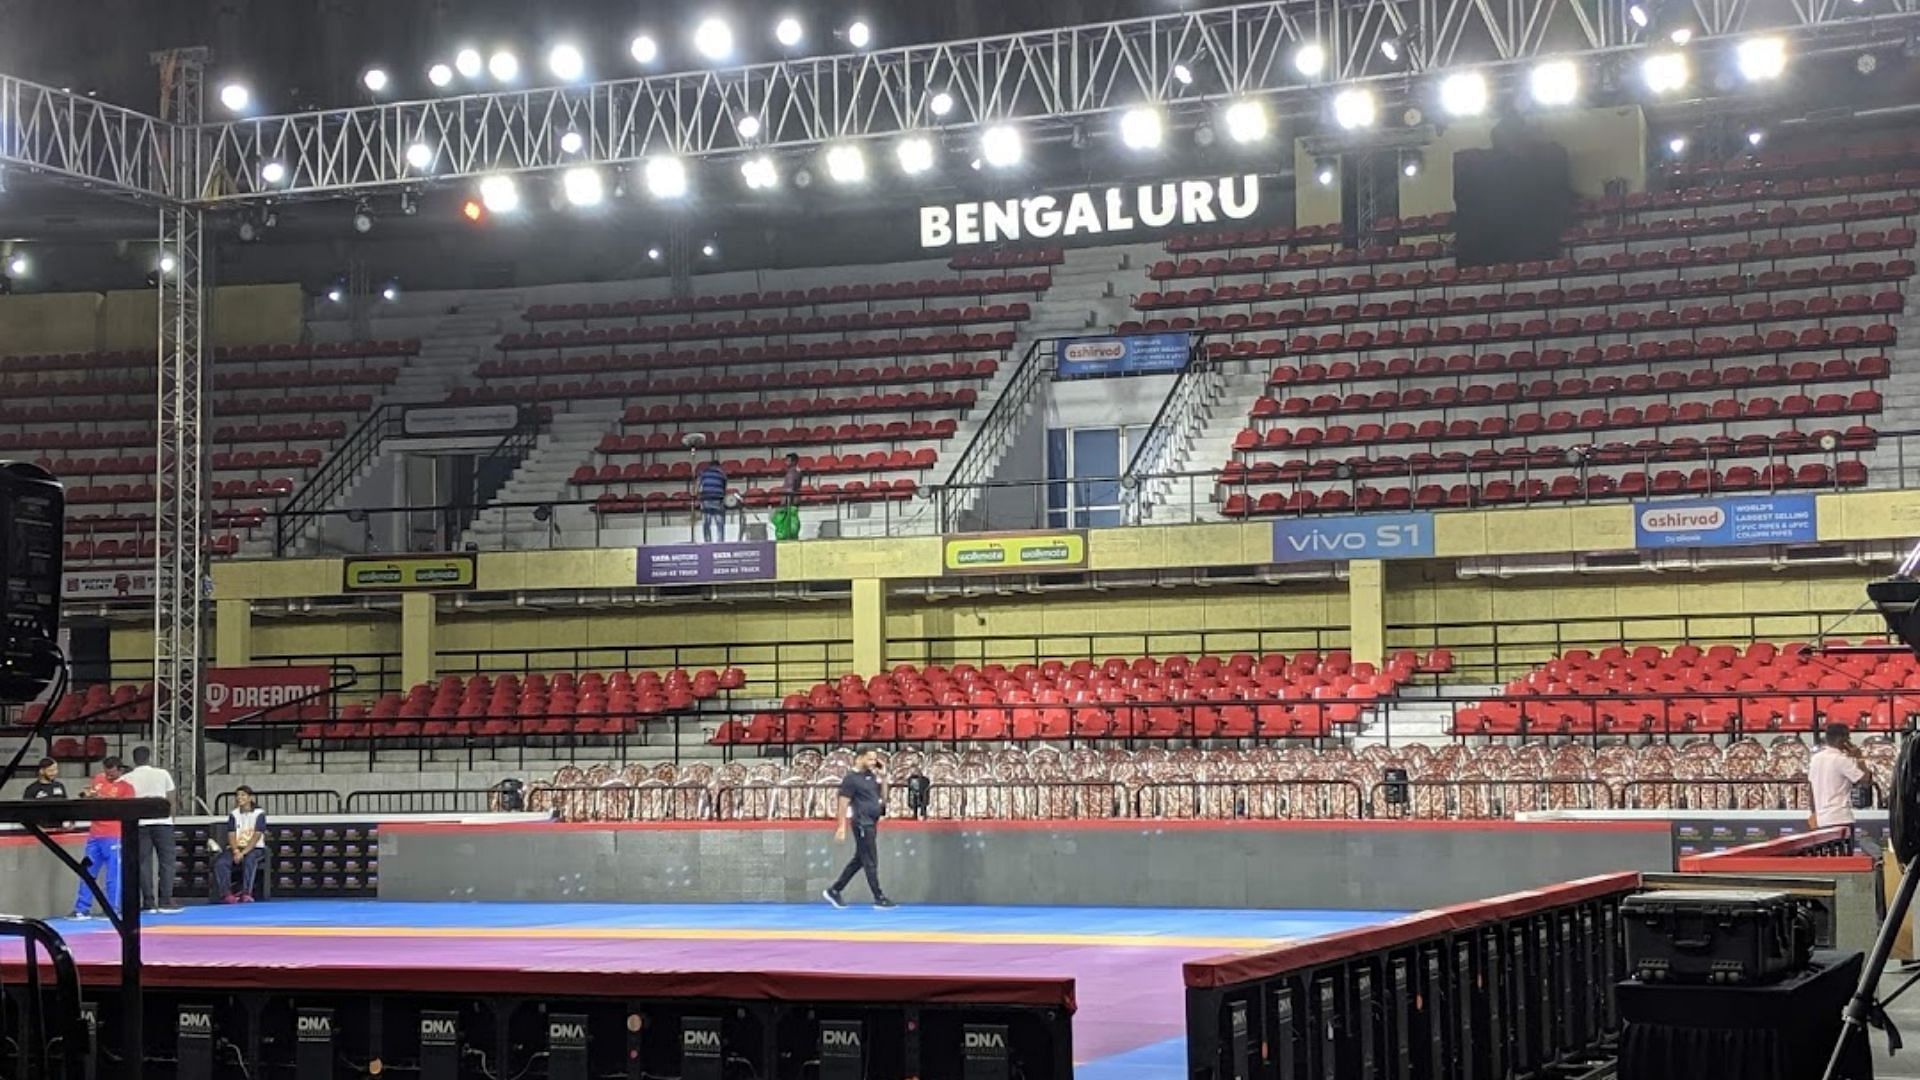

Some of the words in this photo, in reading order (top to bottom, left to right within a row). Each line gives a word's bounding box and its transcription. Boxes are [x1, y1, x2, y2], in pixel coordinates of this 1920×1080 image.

[920, 174, 1260, 248] BENGALURU
[1648, 511, 1719, 528] ashirvad
[1288, 529, 1366, 551] vivo
[1377, 523, 1419, 547] S1
[179, 1012, 211, 1027] DNA
[298, 1016, 331, 1031] DNA
[421, 1020, 456, 1034] DNA
[550, 1024, 585, 1039] DNA
[684, 1030, 721, 1046] DNA
[822, 1030, 861, 1046] DNA
[964, 1032, 1006, 1048] DNA
